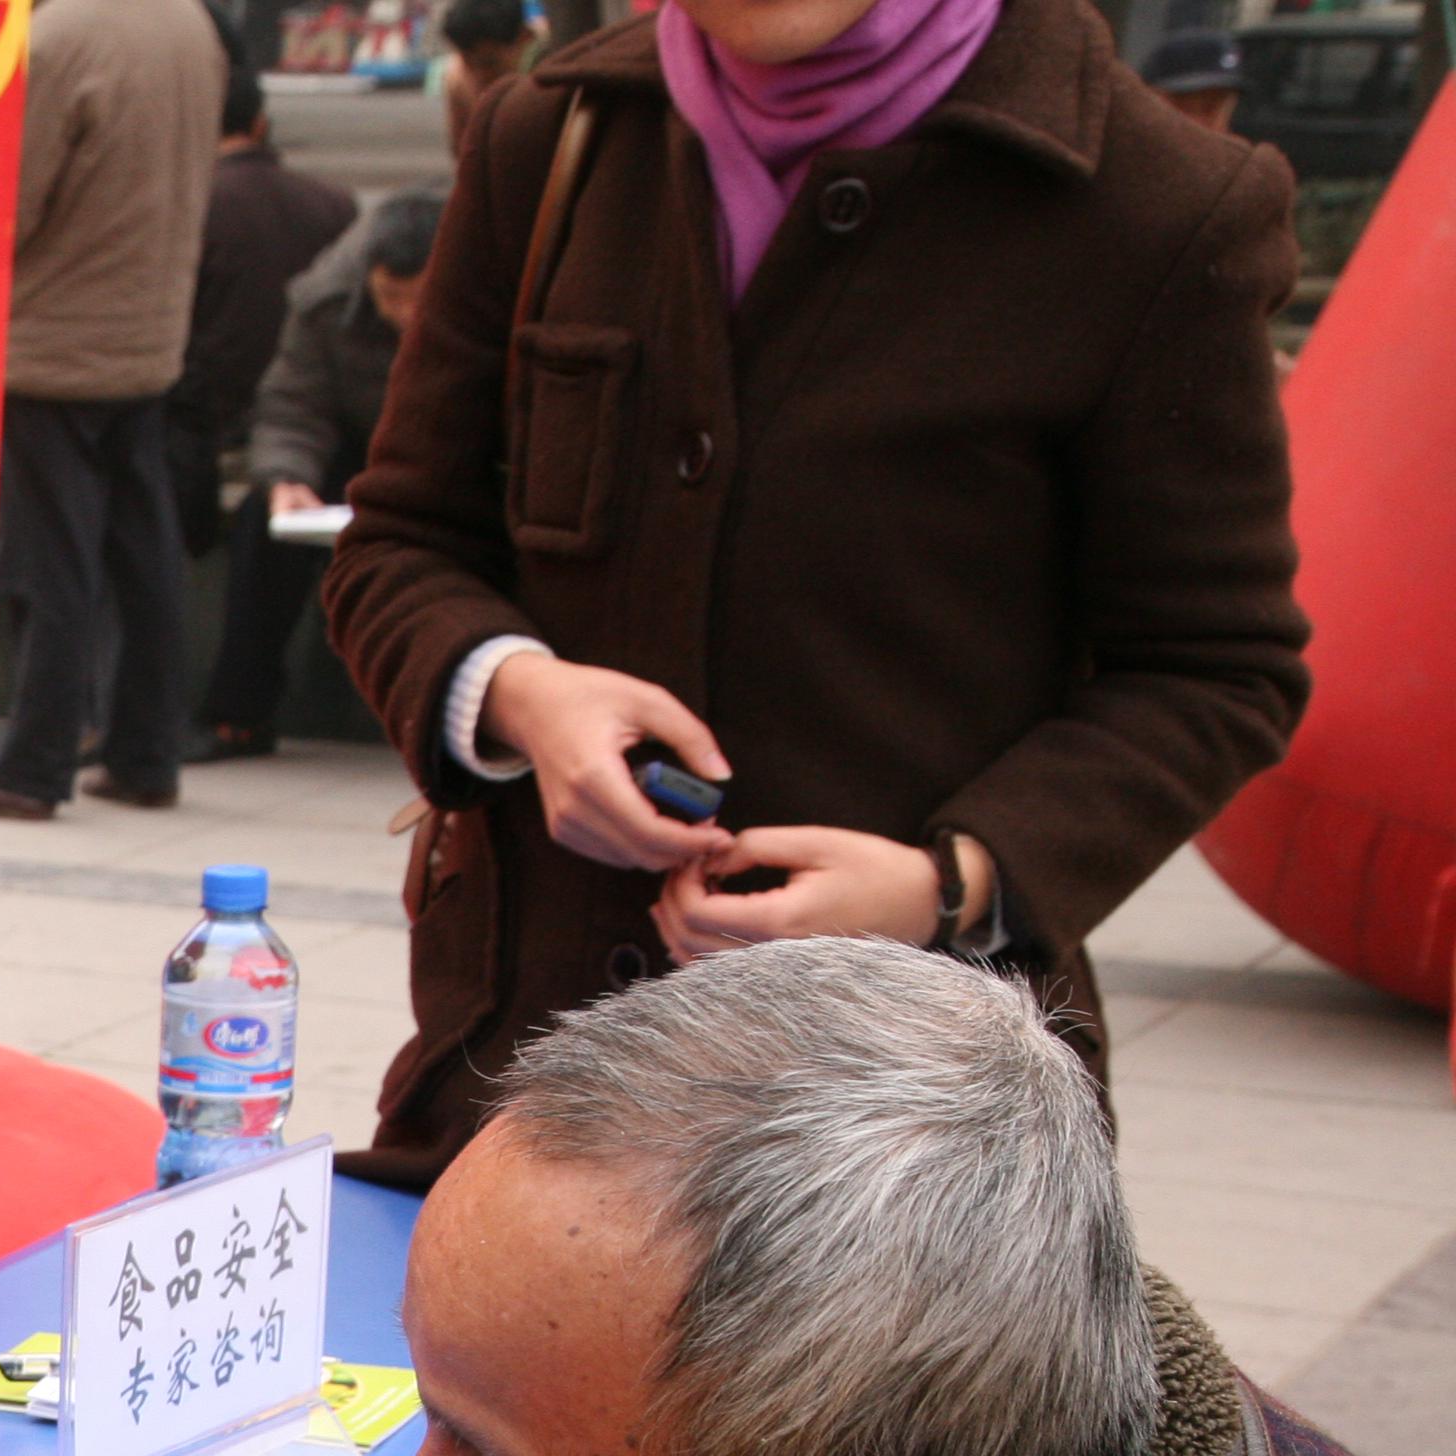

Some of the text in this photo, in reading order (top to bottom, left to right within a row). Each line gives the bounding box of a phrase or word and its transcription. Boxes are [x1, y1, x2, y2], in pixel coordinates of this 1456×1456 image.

[109, 1187, 308, 1342] 食品安全
[120, 1297, 287, 1425] 专家咨询
